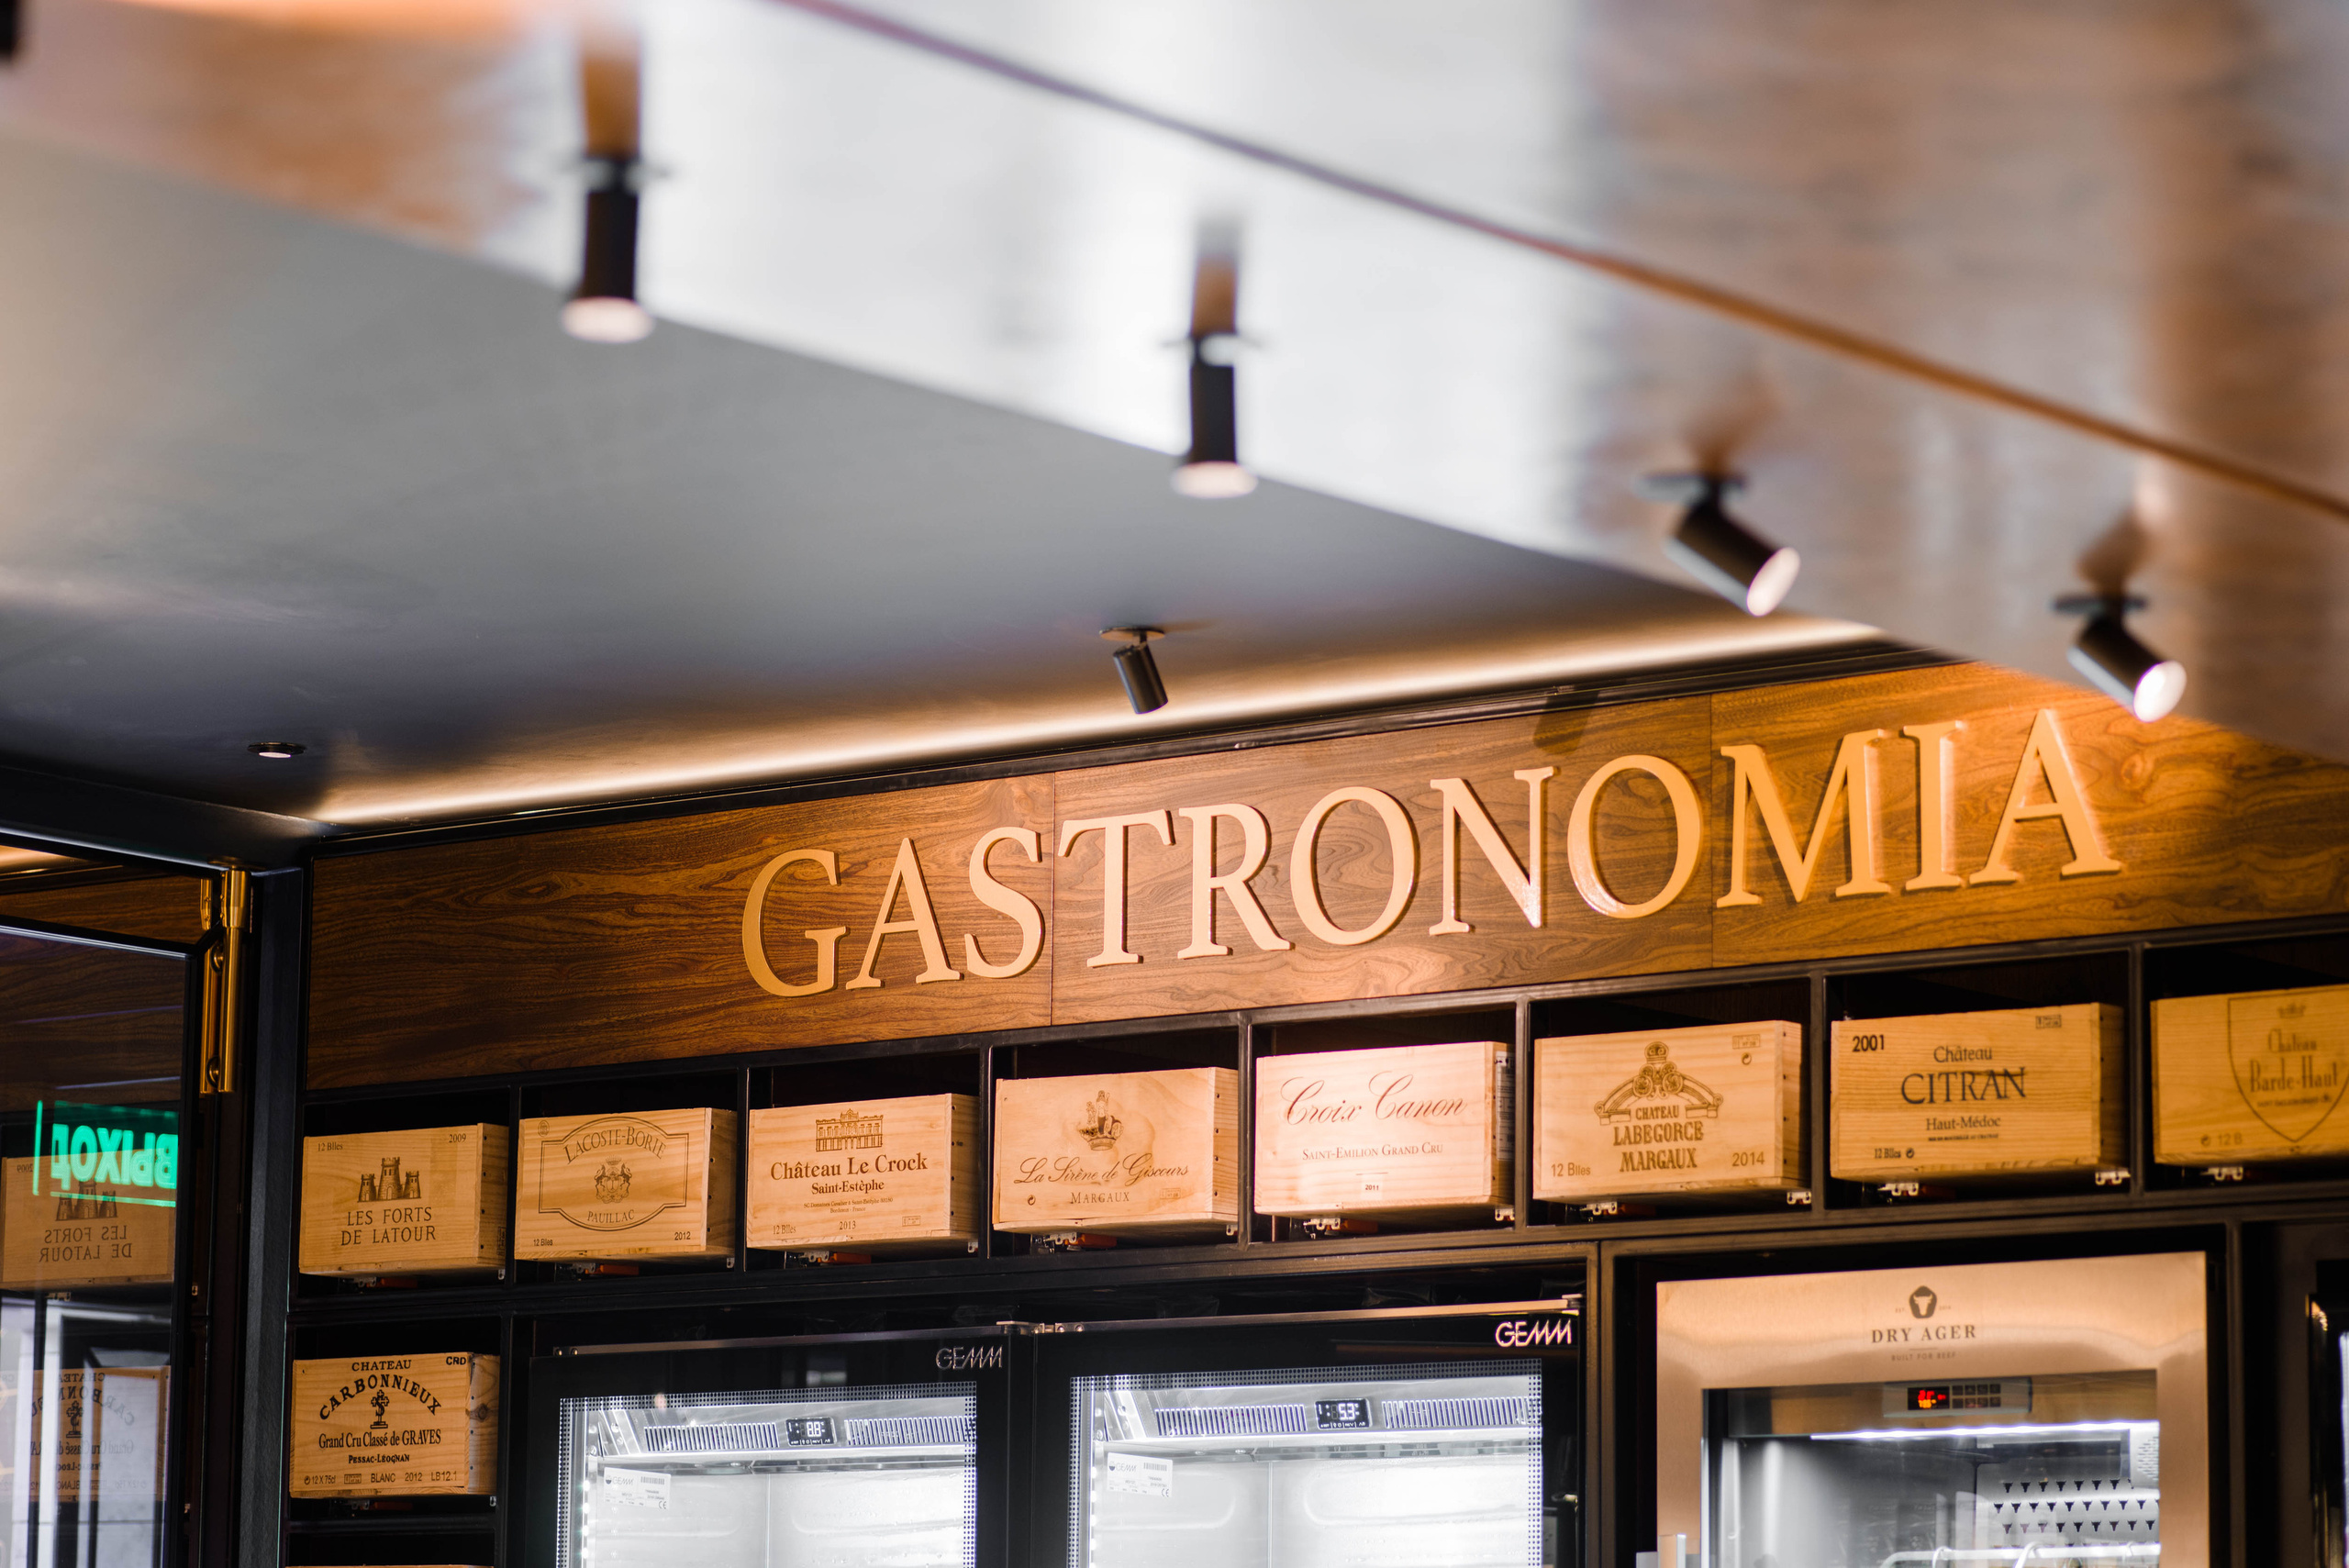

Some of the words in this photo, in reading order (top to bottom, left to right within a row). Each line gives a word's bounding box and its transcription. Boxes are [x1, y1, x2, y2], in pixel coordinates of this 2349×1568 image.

[740, 708, 2124, 998] GASTRONOMIA
[1852, 1035, 1885, 1052] 2001
[1933, 1045, 1992, 1063] Château
[1900, 1066, 2026, 1105] CITRAN
[1280, 1075, 1363, 1126] Croix
[1368, 1070, 1468, 1120] Canon
[1635, 1105, 1680, 1120] CHATEAU
[1926, 1114, 2001, 1131] Haut-Médoc
[449, 1133, 467, 1143] 2009
[1613, 1120, 1704, 1146] LABEGORCE
[317, 1143, 326, 1151] 12
[562, 1126, 667, 1165] LACOSTE-BORIE
[1302, 1147, 1379, 1161] SAINT-EMILION
[1382, 1144, 1419, 1156] GRAND
[1422, 1141, 1443, 1154] CRU
[1875, 1148, 1882, 1159] 12
[771, 1161, 841, 1181] Château
[847, 1156, 869, 1175] Le
[874, 1152, 928, 1173] Crock
[1620, 1148, 1698, 1173] MARGAUX
[1731, 1151, 1765, 1167] 2014
[1014, 1157, 1048, 1184] La
[1048, 1156, 1098, 1183] Sirène
[1101, 1161, 1120, 1180] de
[1122, 1152, 1189, 1186] Giscours
[1551, 1163, 1564, 1177] 12
[811, 1179, 885, 1195] Saint-Estèphe
[1070, 1192, 1130, 1204] MARGAUX
[347, 1210, 373, 1226] LES
[383, 1207, 432, 1224] FORTS
[587, 1209, 635, 1224] PAUILLAC
[839, 1220, 856, 1230] 2013
[340, 1229, 362, 1246] DE
[372, 1225, 436, 1244] LATOUR
[674, 1231, 691, 1241] 2012
[773, 1225, 780, 1235] 12
[533, 1239, 540, 1247] 12
[1495, 1318, 1573, 1348] GEMM
[1872, 1328, 1912, 1343] DRY
[1920, 1325, 1976, 1341] AGER
[351, 1360, 412, 1372] CHATEAU
[446, 1356, 467, 1365] CRD
[936, 1345, 1003, 1370] GEMM
[319, 1373, 442, 1420] CARBONNIEUX
[318, 1433, 344, 1449] Grand
[346, 1433, 362, 1447] Cru
[362, 1430, 388, 1447] Classé
[390, 1431, 400, 1446] de
[402, 1429, 441, 1445] GRAVES
[371, 1473, 395, 1483] BLANC
[405, 1472, 423, 1482] 2012
